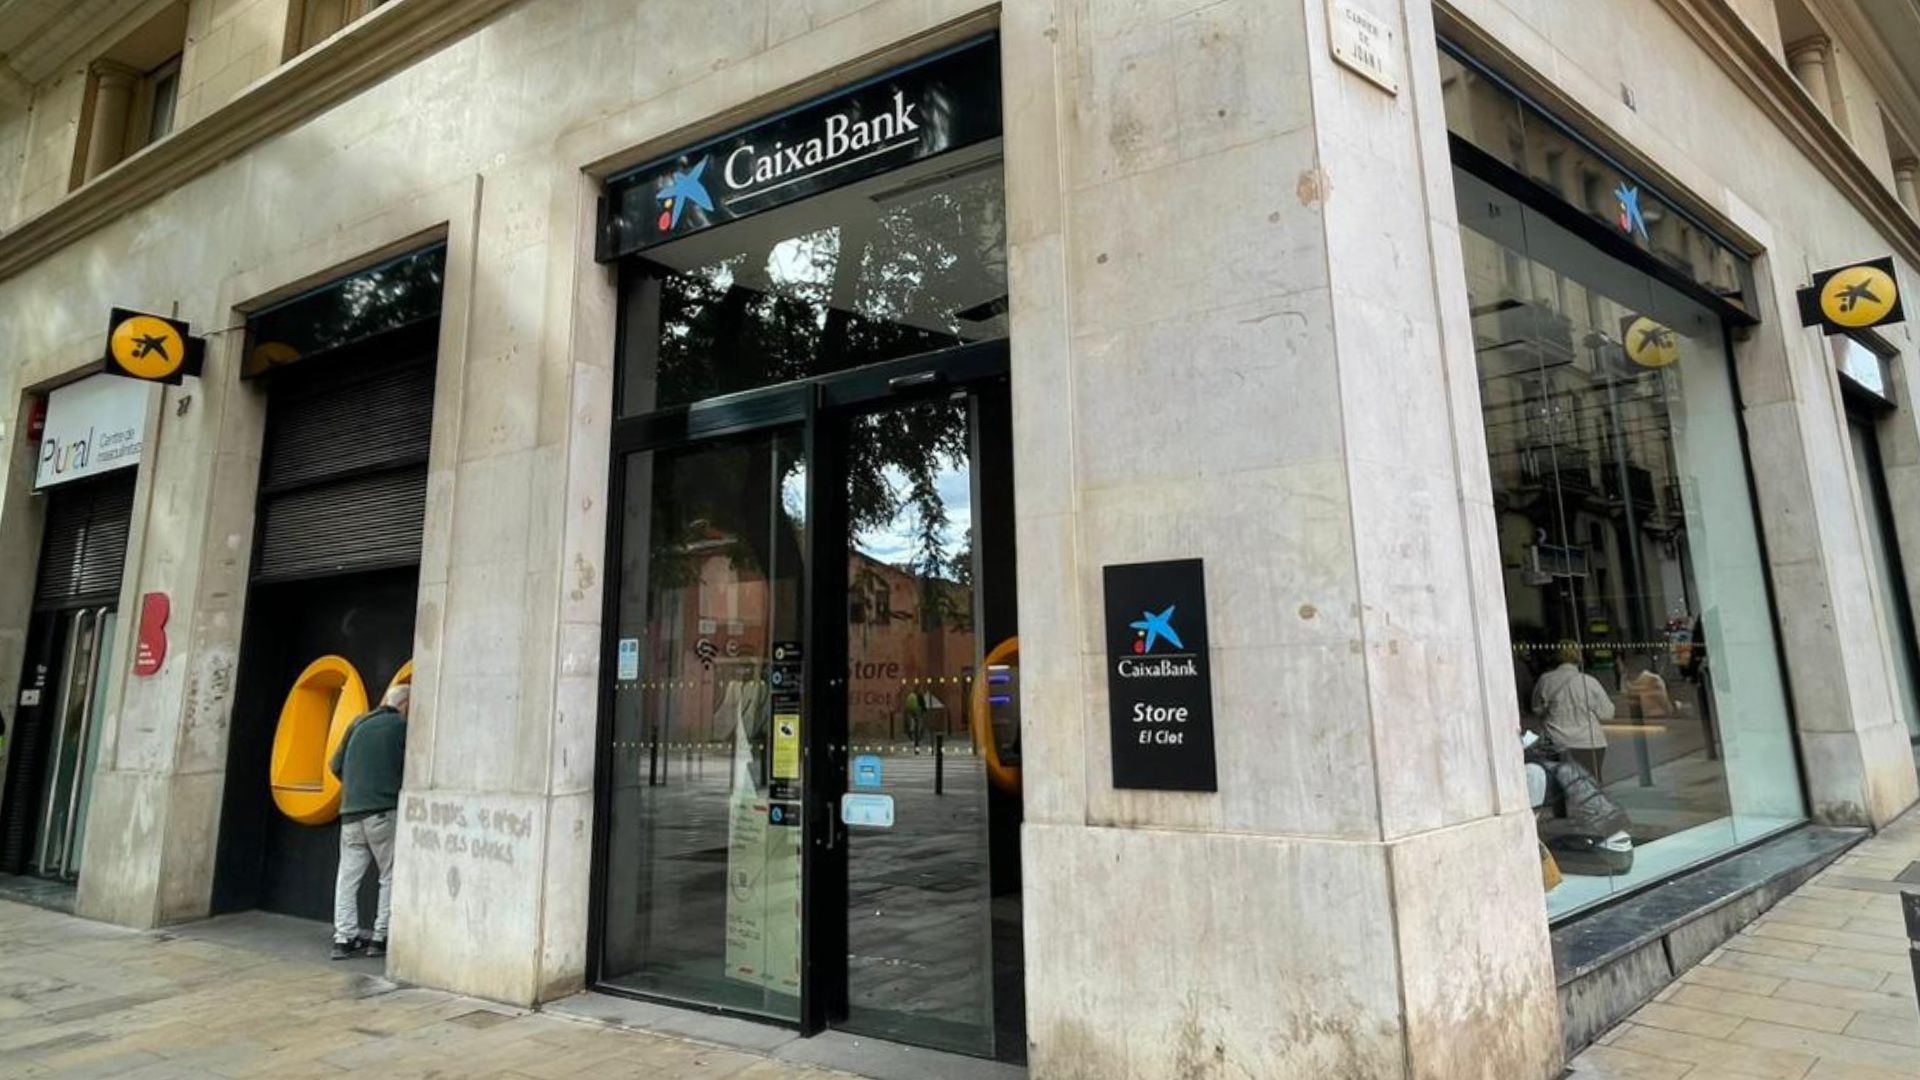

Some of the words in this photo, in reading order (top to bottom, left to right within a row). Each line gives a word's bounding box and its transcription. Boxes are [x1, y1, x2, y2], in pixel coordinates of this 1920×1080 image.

[724, 90, 919, 190] CaixaBank
[38, 426, 94, 477] Plural
[1118, 658, 1198, 677] CaixaBank
[1132, 702, 1188, 722] Store
[1139, 729, 1152, 744] El
[1155, 729, 1183, 744] Clot
